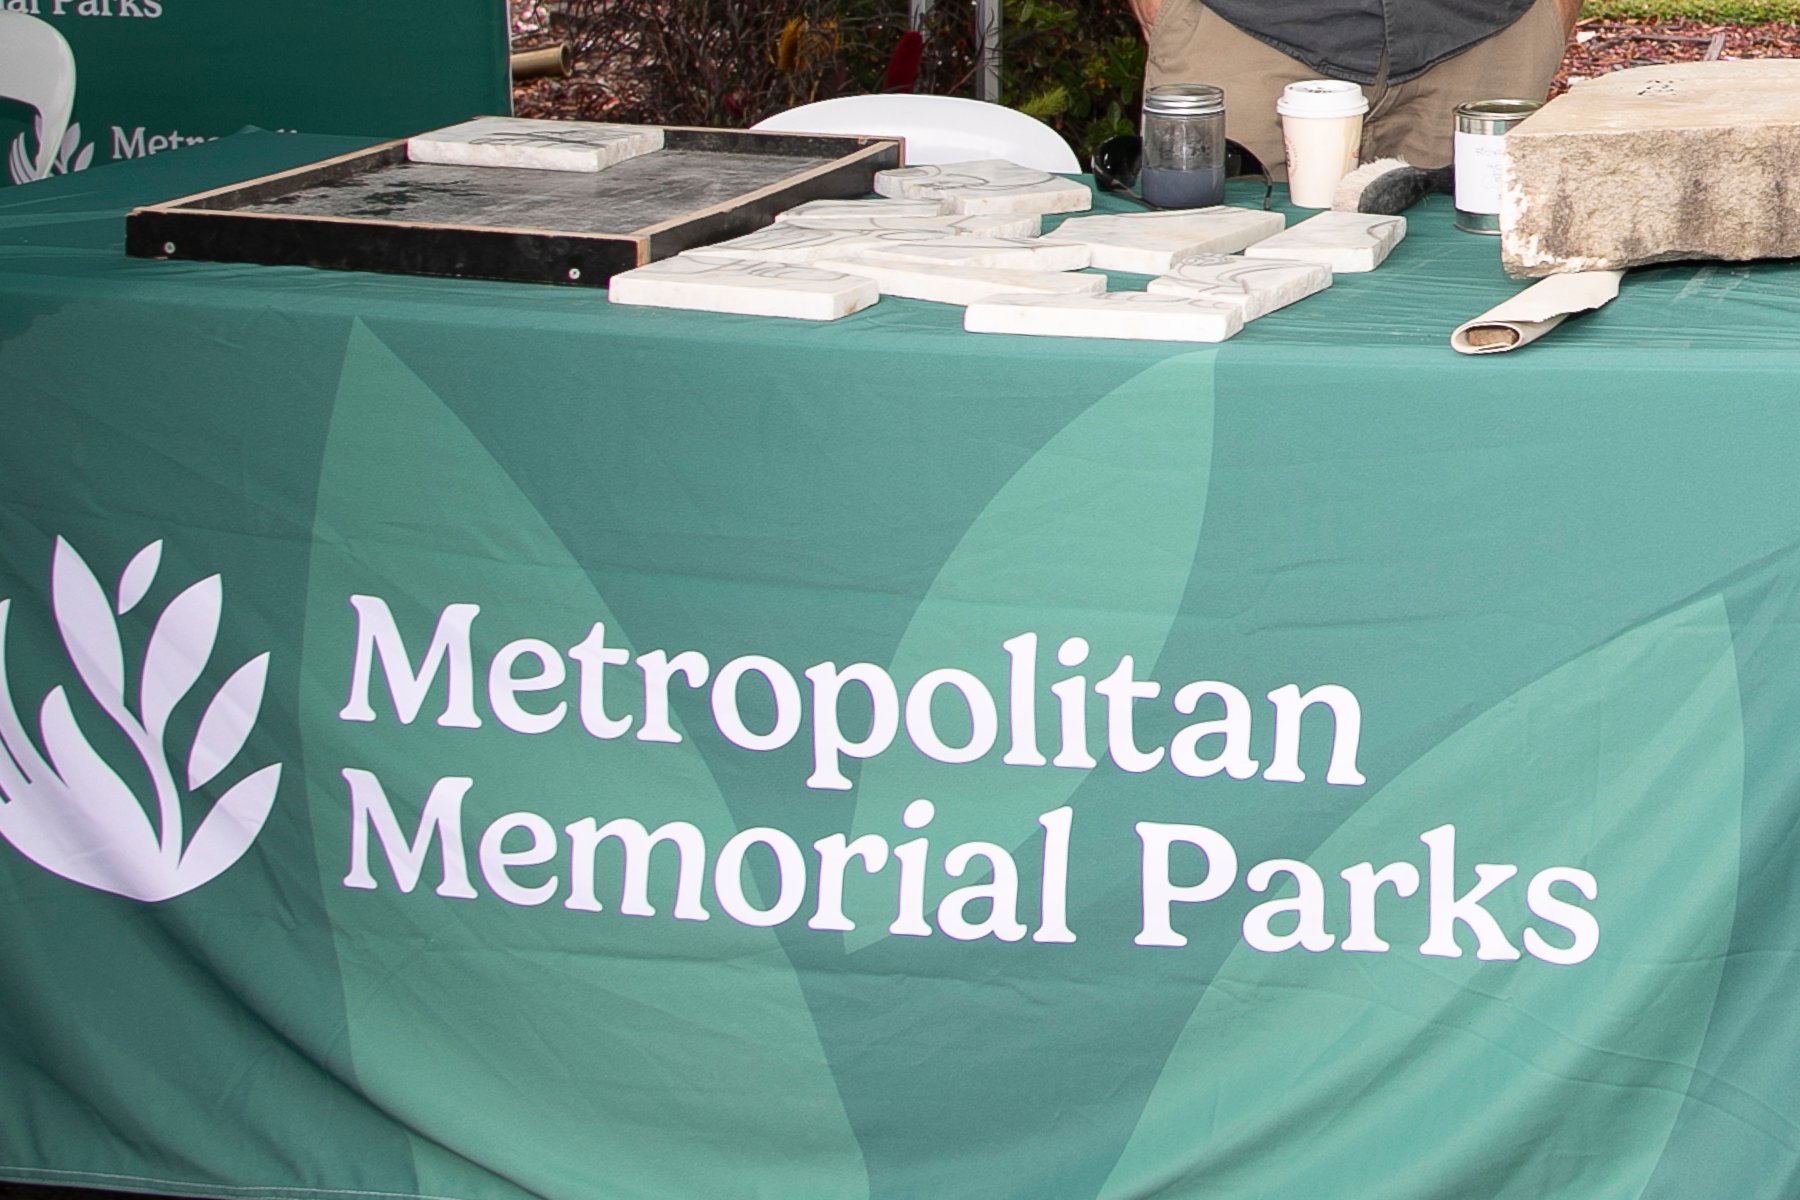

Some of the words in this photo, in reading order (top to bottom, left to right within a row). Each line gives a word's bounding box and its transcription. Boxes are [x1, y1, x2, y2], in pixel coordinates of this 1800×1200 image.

[340, 595, 1366, 790] Metropolitan
[343, 768, 1077, 943] Memorial
[1135, 822, 1600, 964] Parks
